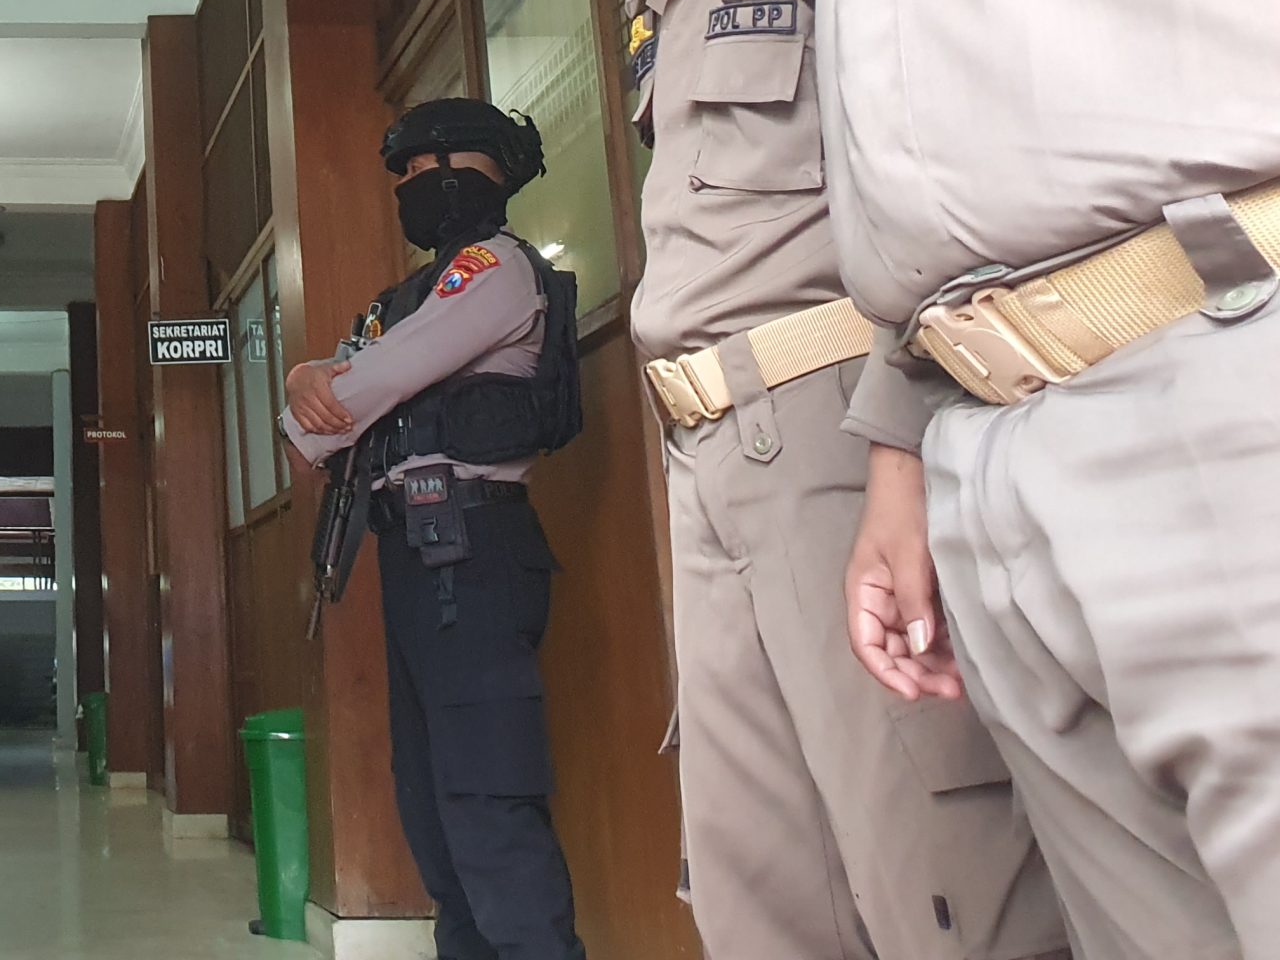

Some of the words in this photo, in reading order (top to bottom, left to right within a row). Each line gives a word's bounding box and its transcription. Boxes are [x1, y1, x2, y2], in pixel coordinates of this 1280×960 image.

[711, 8, 740, 32] POL
[752, 5, 783, 28] PP
[152, 324, 225, 339] SEKRETARIAT
[157, 340, 223, 359] KORPRI
[87, 431, 127, 439] PROTOKOL
